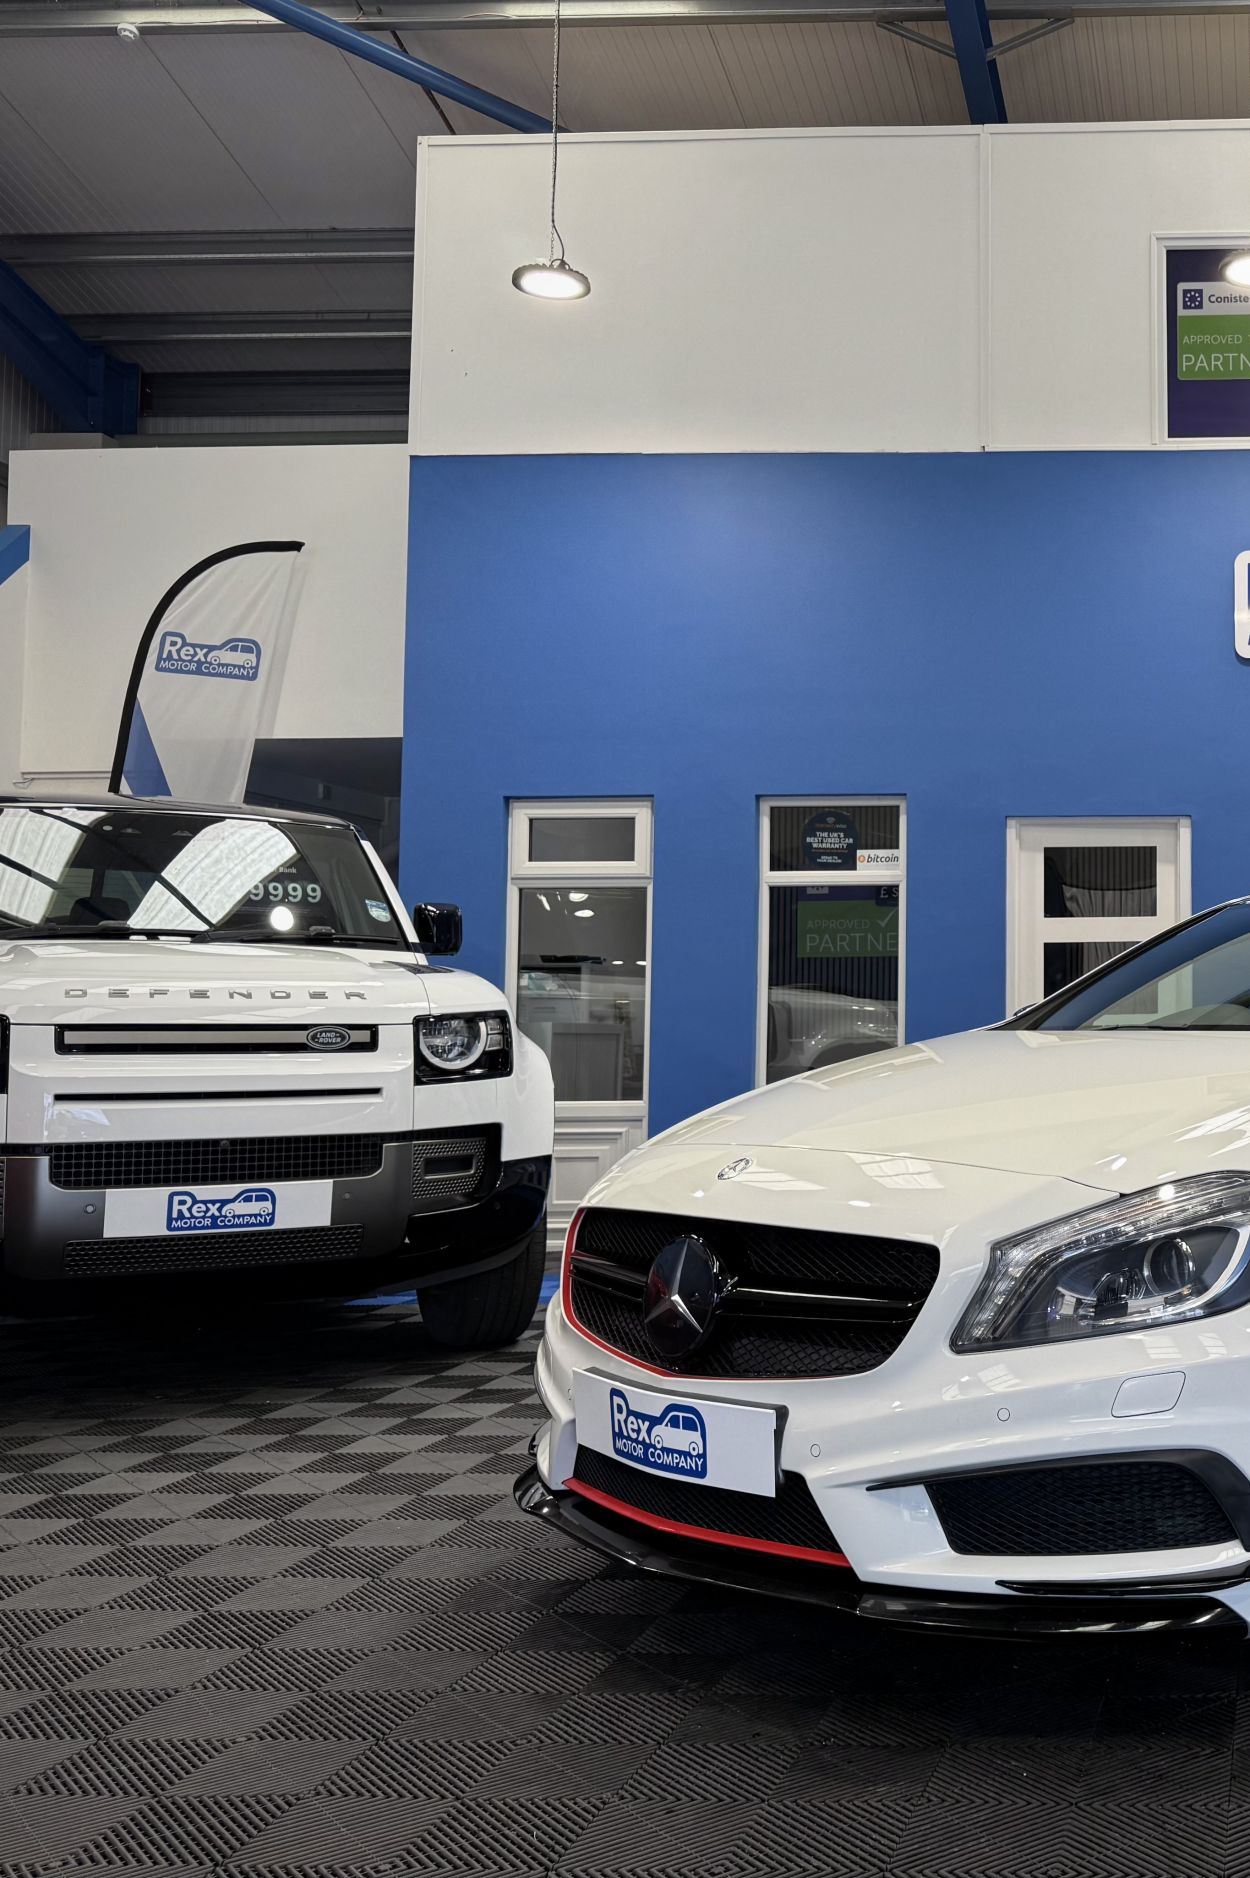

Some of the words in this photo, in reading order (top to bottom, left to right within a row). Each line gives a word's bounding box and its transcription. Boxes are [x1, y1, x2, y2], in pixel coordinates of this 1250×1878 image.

[1182, 335, 1243, 345] APPROVED
[162, 635, 209, 662] Rex
[159, 660, 197, 671] MOTOR
[201, 663, 255, 677] COMPANY
[866, 853, 899, 863] bitcoin
[806, 919, 870, 929] APPROVED
[806, 932, 898, 952] PARTNE
[63, 987, 367, 1000] DEFENDER
[171, 1195, 221, 1218] Rex
[171, 1218, 212, 1228] MOTOR
[217, 1215, 273, 1226] COMPANY
[612, 1395, 651, 1444] Rex
[615, 1436, 644, 1459] MOTOR
[647, 1448, 703, 1471] COMPANY
